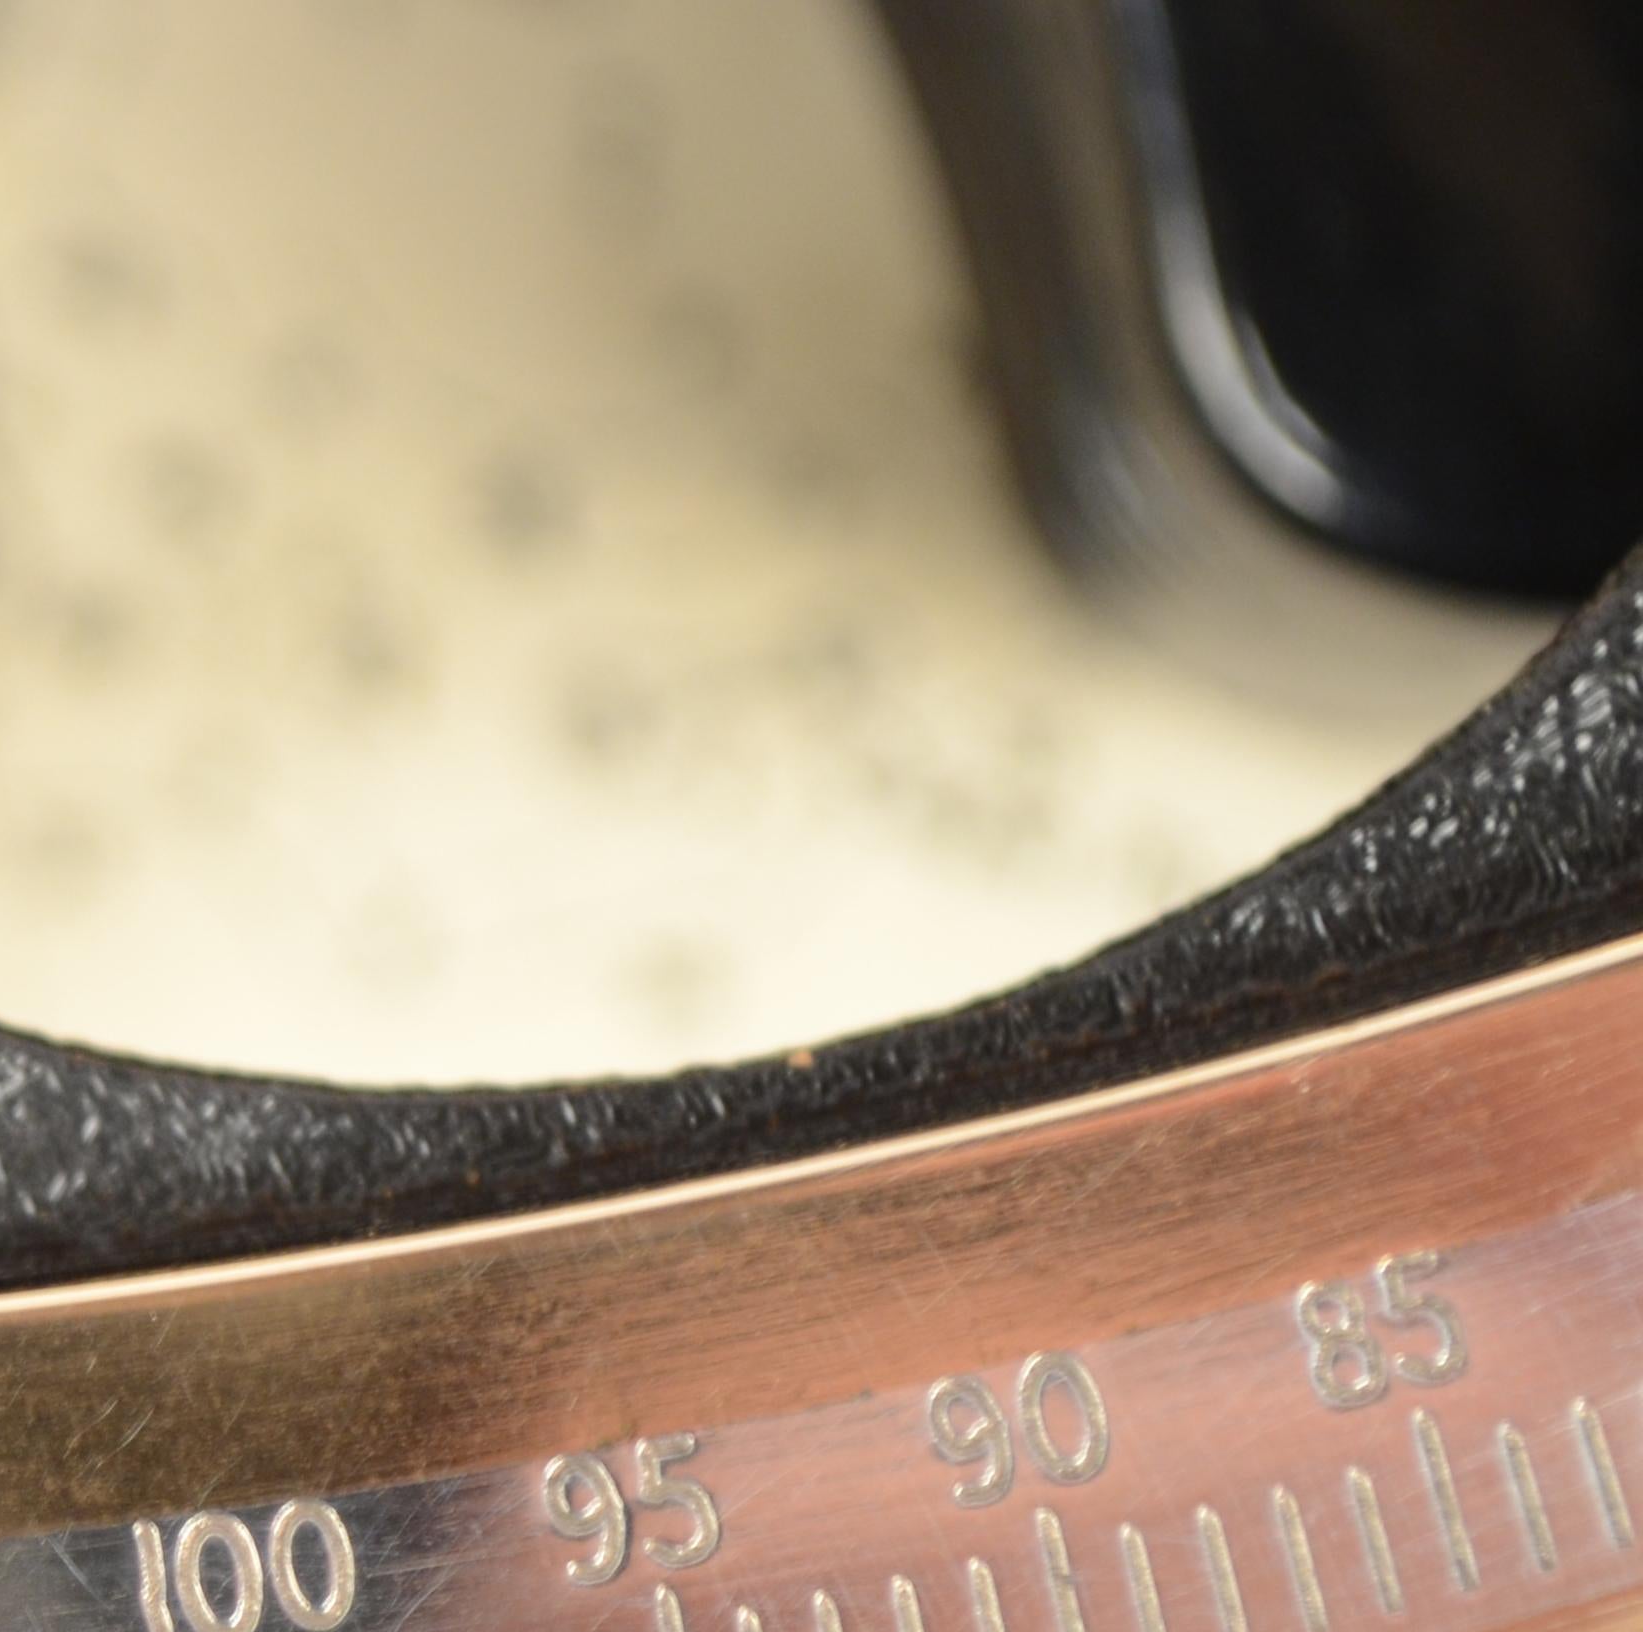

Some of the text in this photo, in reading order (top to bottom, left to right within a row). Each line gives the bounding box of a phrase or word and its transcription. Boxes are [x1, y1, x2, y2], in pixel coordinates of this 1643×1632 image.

[538, 1432, 721, 1587] 95
[924, 1350, 1109, 1505] 90
[1294, 1251, 1469, 1408] 85
